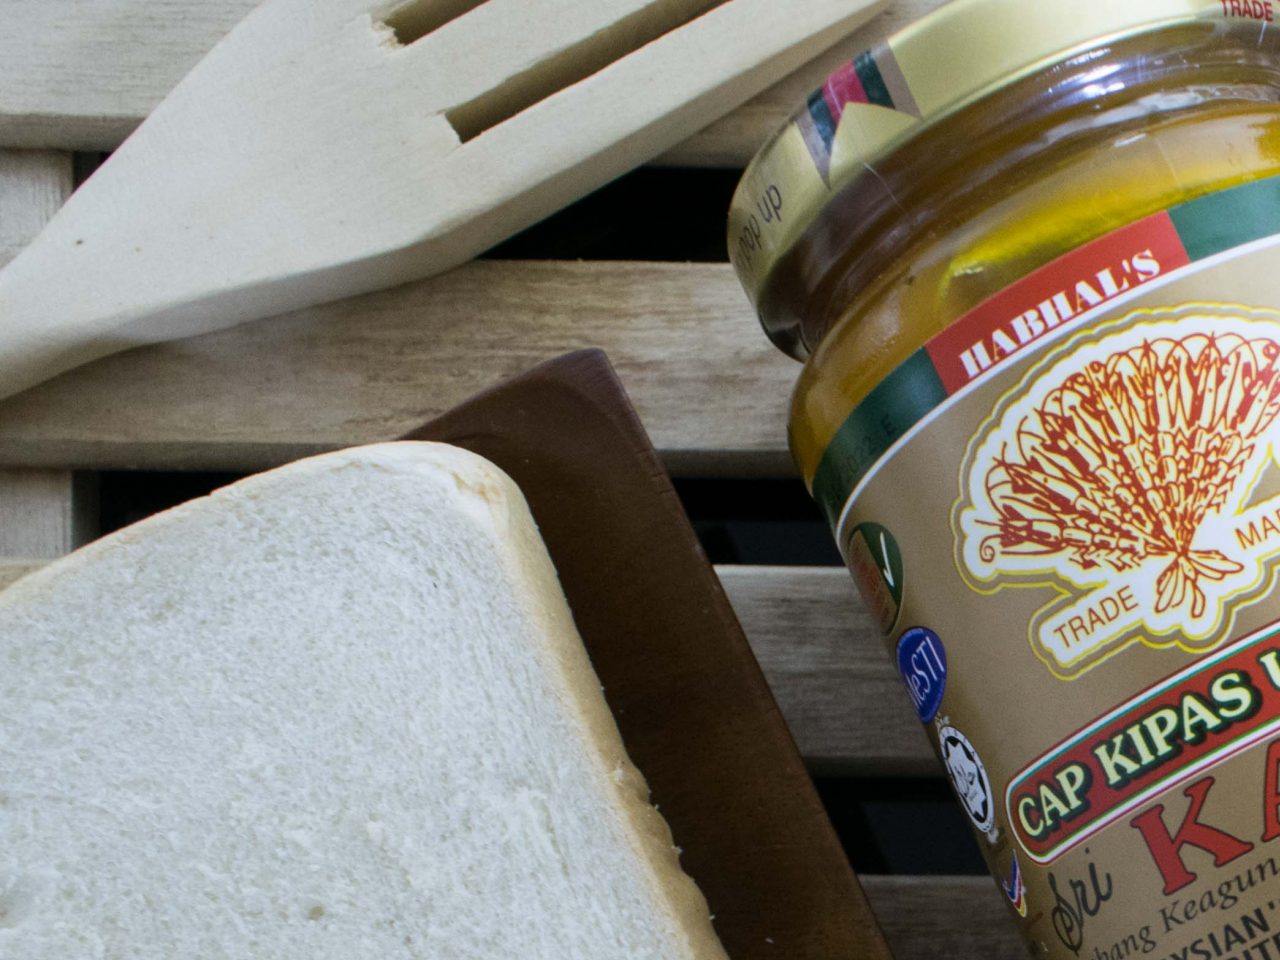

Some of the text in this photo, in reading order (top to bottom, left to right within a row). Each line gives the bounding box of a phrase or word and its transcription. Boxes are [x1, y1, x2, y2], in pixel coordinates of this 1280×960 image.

[1221, 0, 1273, 21] TRADE
[757, 185, 782, 223] up
[959, 249, 1160, 379] HABHAL'S
[1053, 585, 1139, 648] TRADE
[1018, 764, 1087, 838] CAP
[1095, 672, 1253, 787] KIPAS
